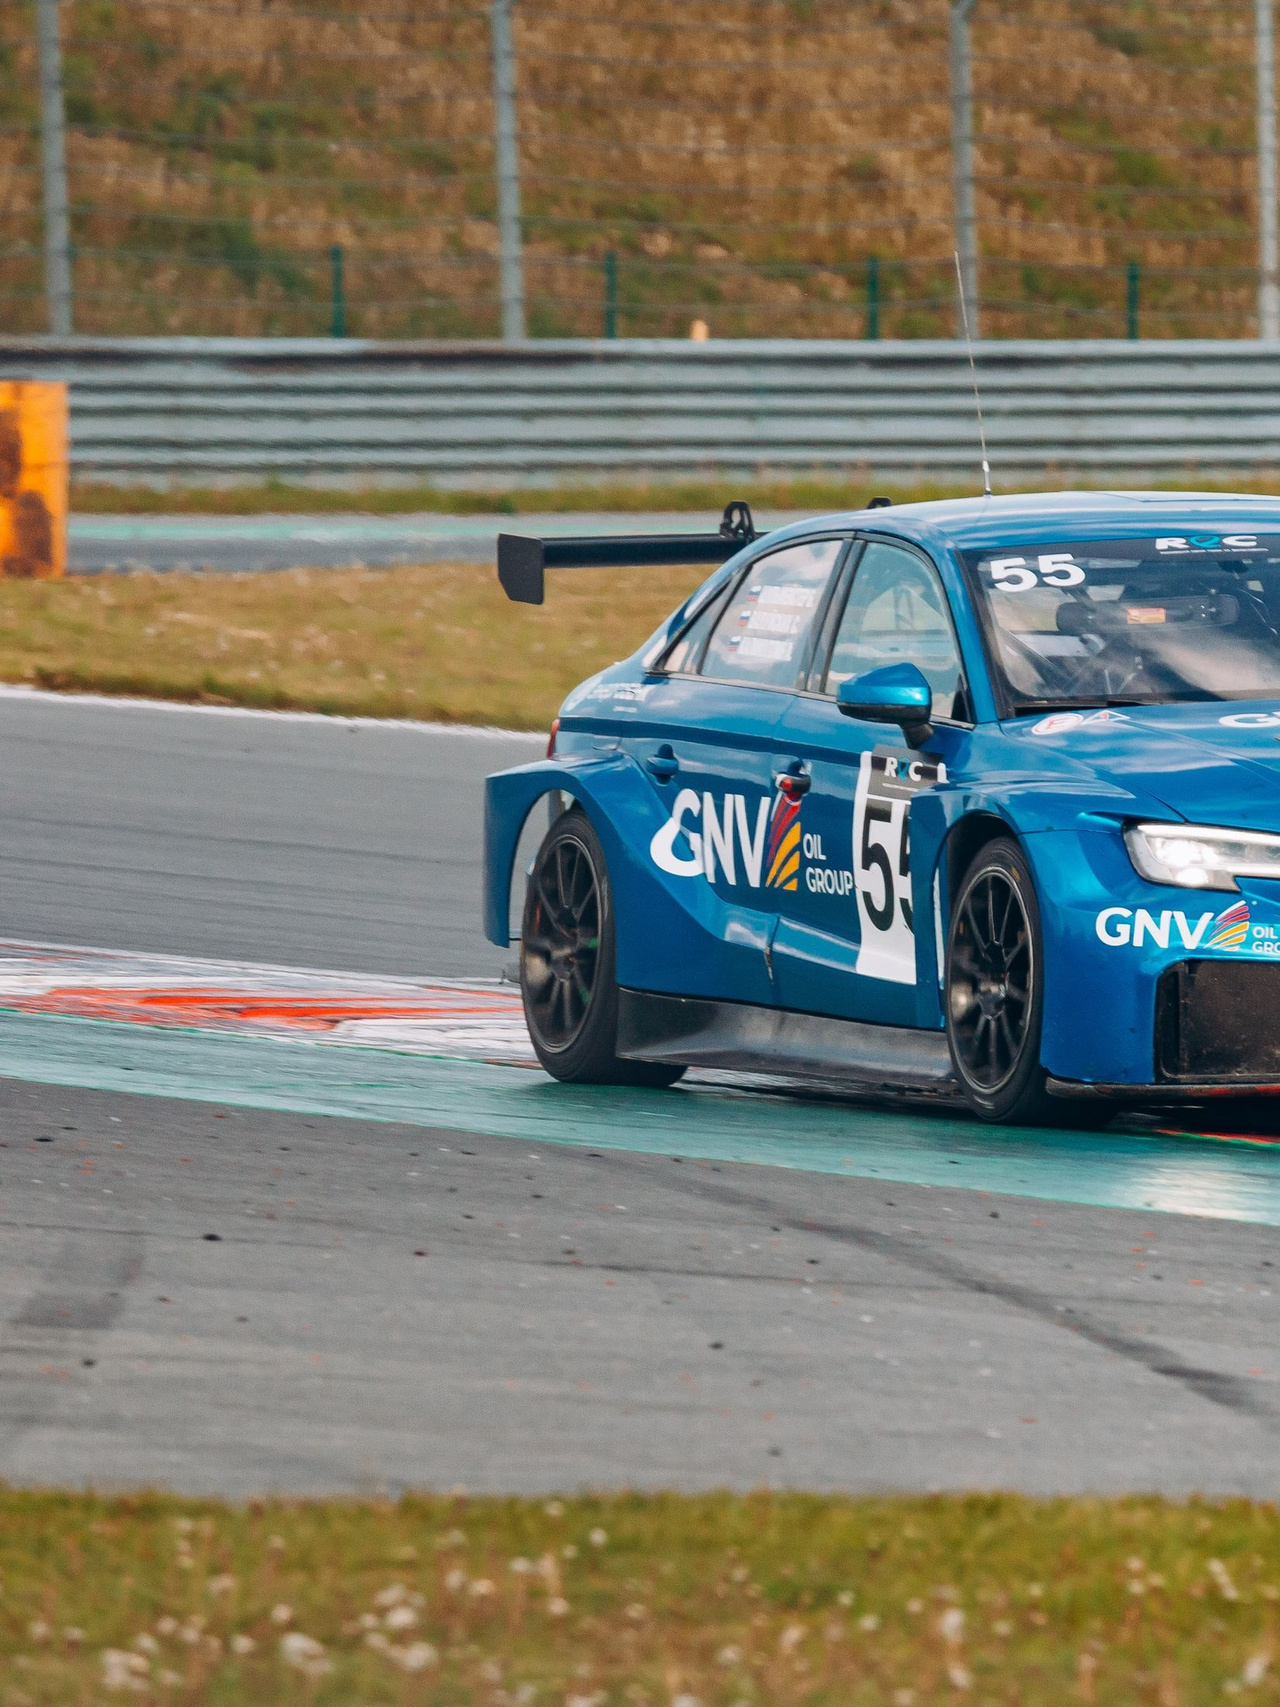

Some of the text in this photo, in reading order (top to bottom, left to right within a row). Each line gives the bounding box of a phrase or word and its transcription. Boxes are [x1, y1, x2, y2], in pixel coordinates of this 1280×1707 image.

[990, 553, 1086, 592] 55
[650, 788, 771, 888] GNV
[803, 833, 826, 860] OIL
[805, 867, 853, 896] GROUP
[1095, 907, 1214, 950] GNV
[1252, 926, 1278, 940] OIL
